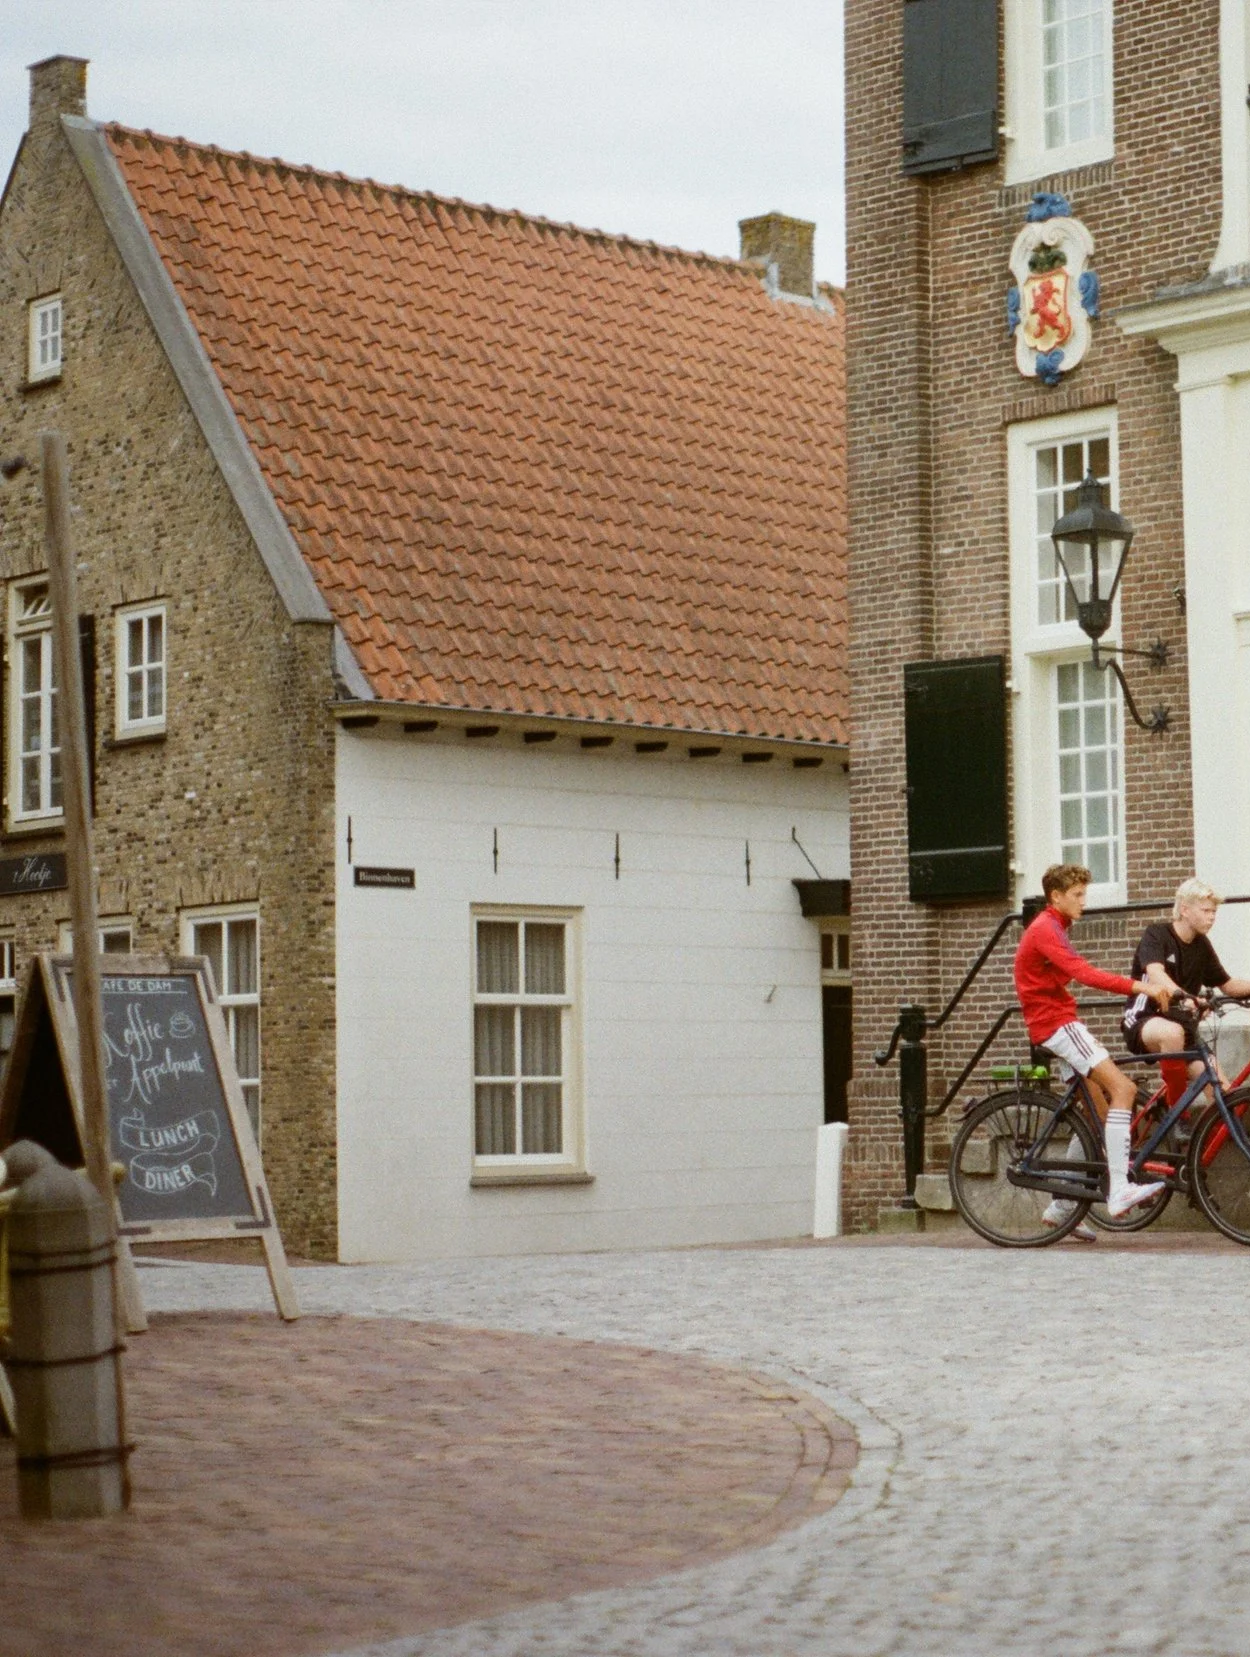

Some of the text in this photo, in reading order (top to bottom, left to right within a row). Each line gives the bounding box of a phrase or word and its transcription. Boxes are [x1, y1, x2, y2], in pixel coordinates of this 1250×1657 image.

[359, 871, 411, 883] Binnenhaven
[129, 980, 144, 992] DE
[148, 980, 172, 992] DAM
[140, 1119, 200, 1148] LUNCH
[144, 1164, 198, 1191] DINER
